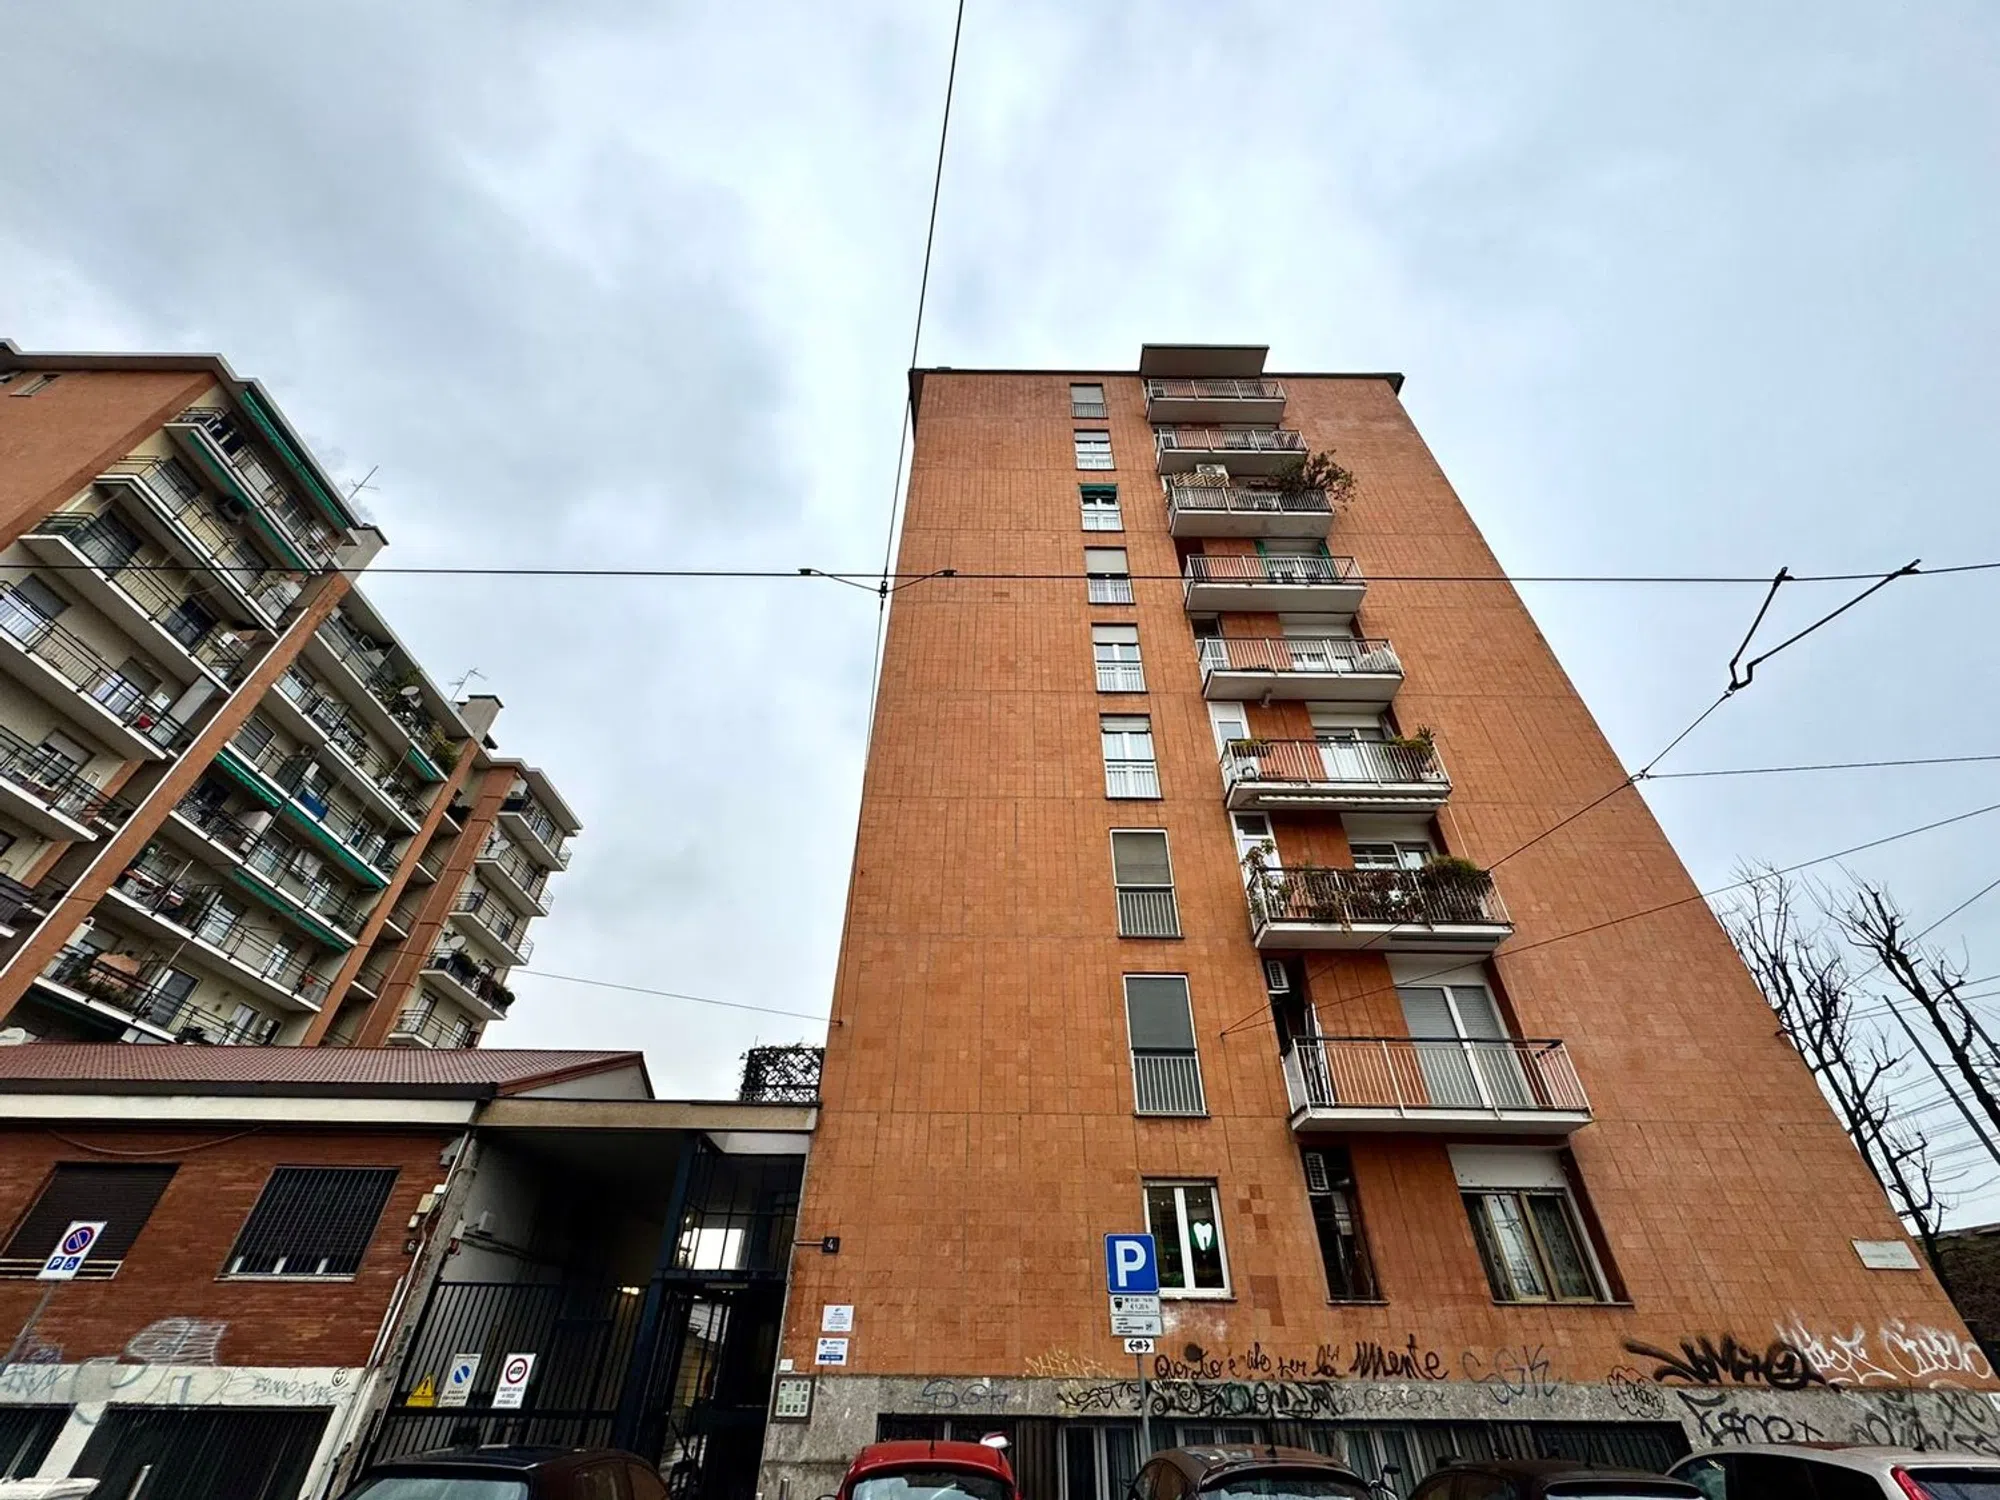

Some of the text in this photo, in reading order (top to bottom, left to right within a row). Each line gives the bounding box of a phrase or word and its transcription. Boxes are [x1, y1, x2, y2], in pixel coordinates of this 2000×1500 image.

[828, 1239, 834, 1250] 4
[50, 1257, 63, 1269] P
[1115, 1240, 1147, 1287] P
